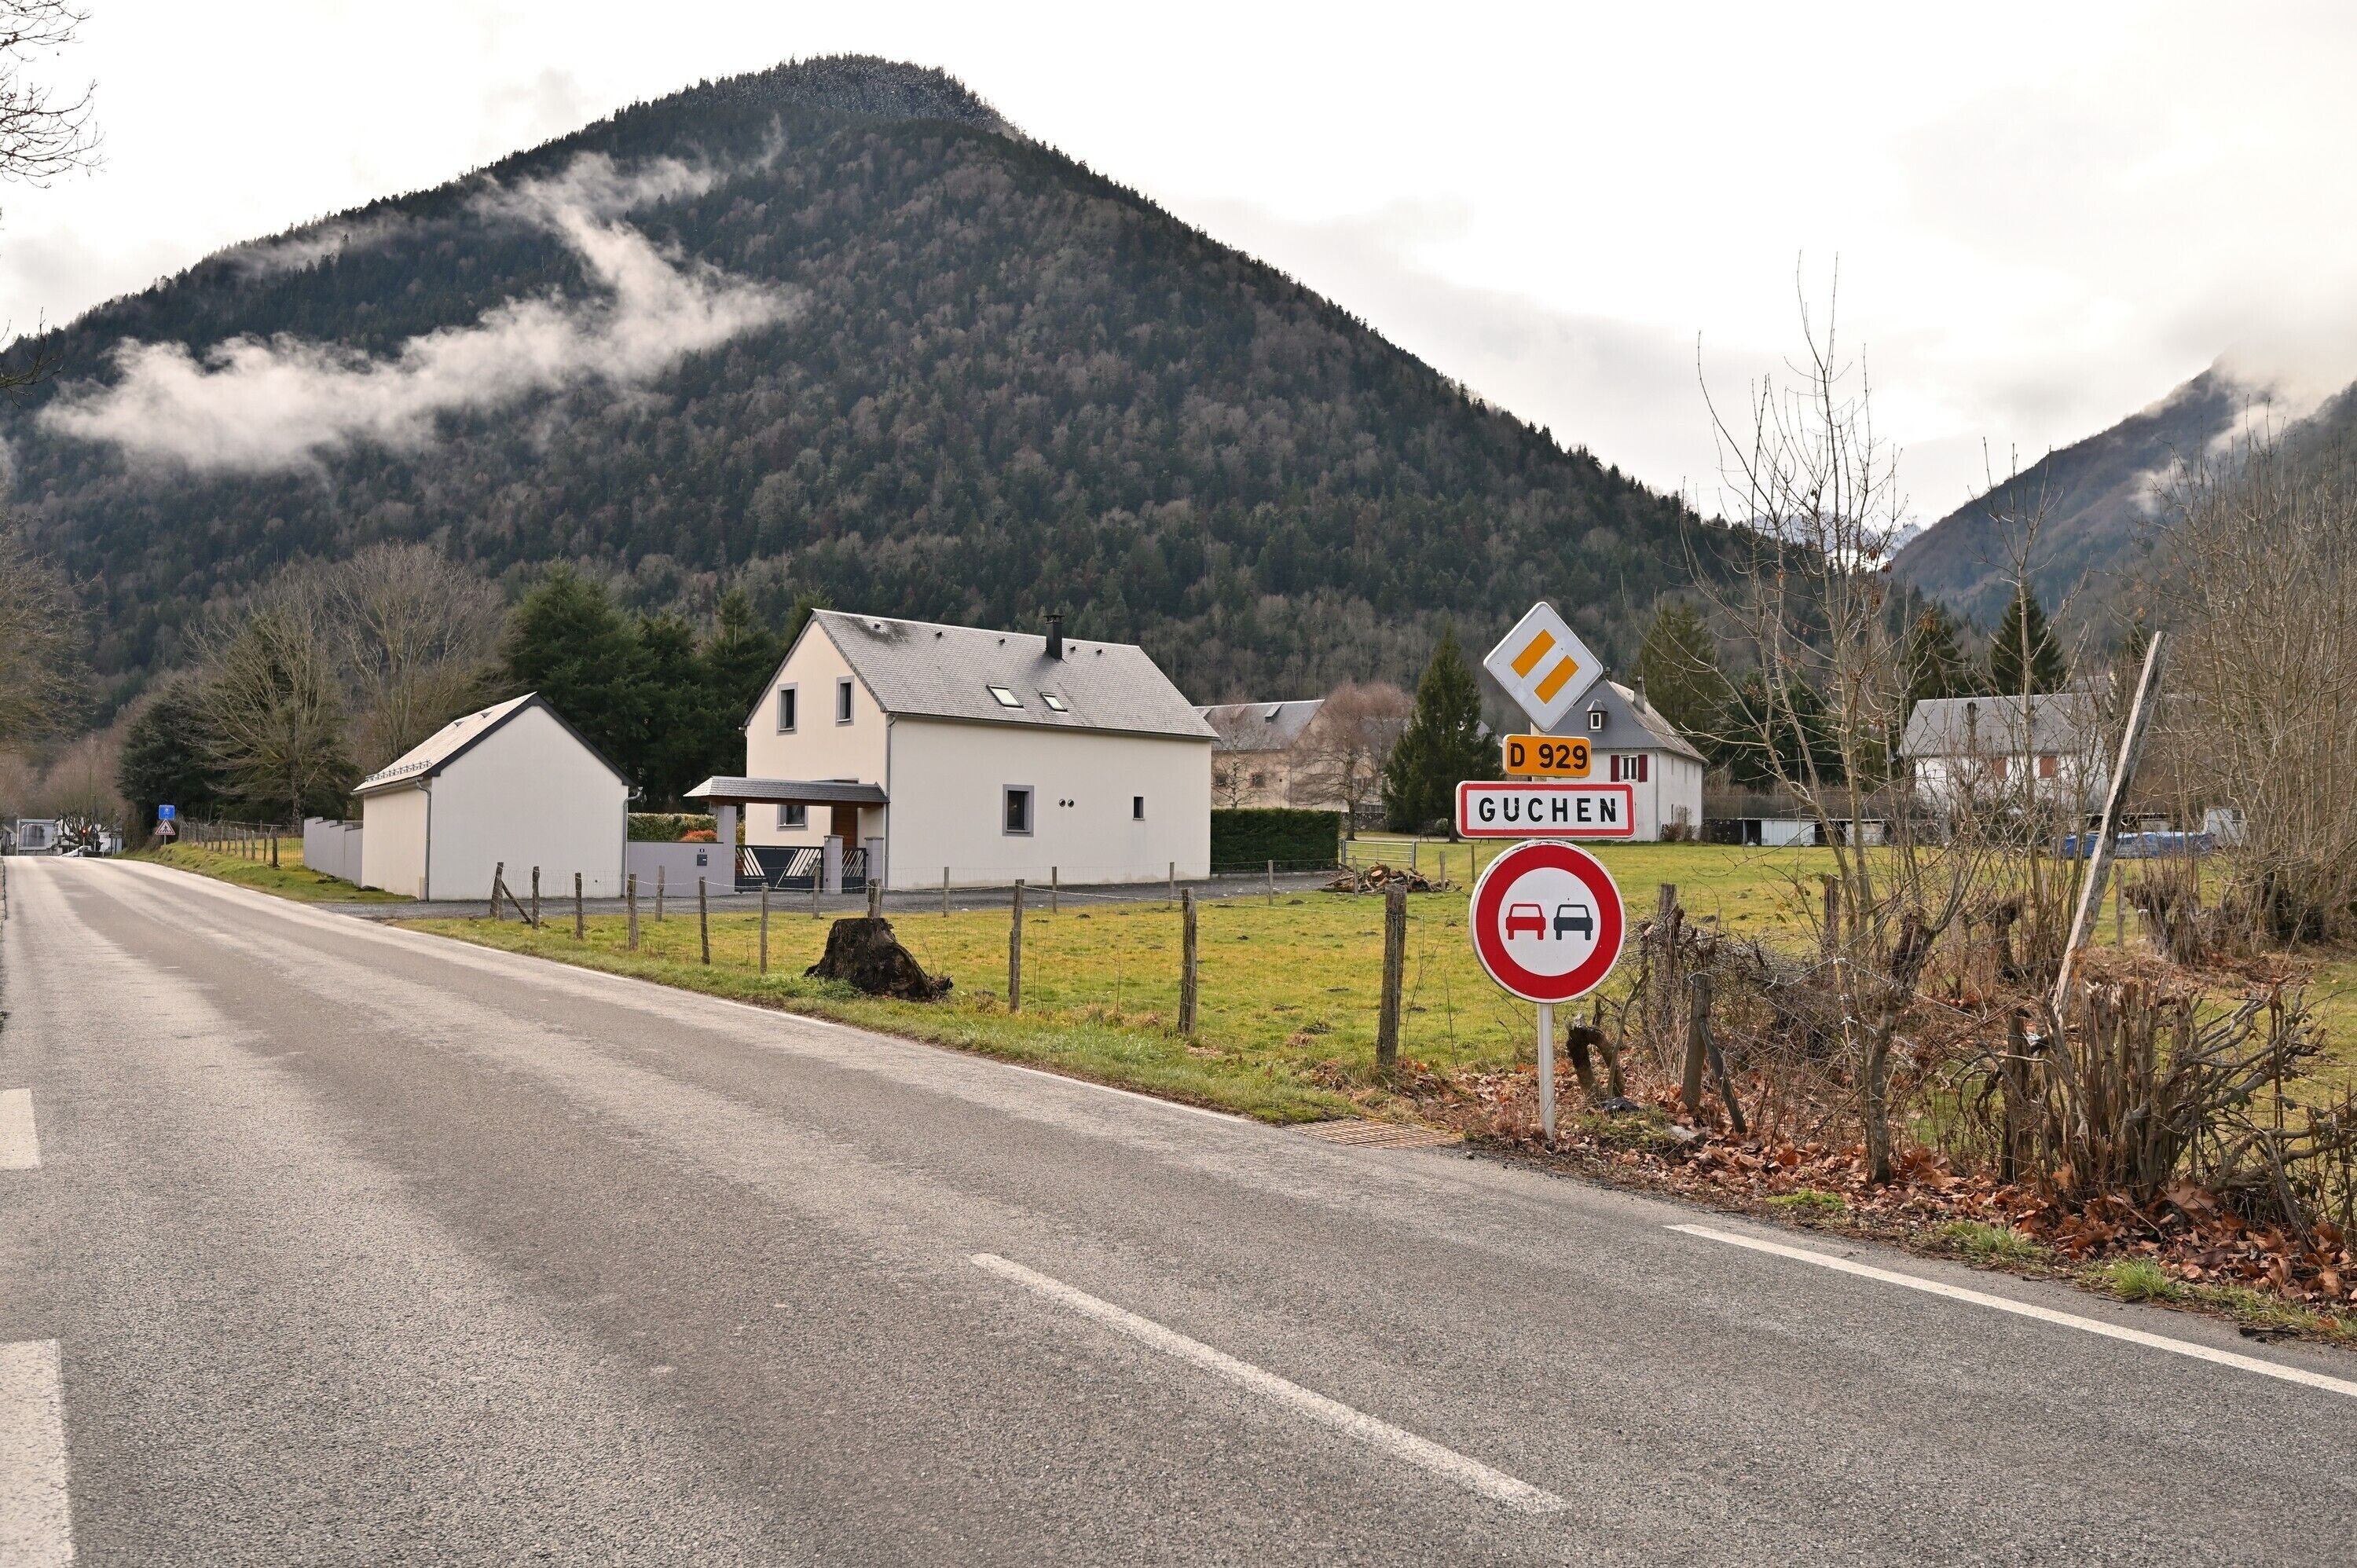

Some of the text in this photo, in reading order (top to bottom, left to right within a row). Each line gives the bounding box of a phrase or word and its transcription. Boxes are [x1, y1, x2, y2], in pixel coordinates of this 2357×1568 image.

[1510, 742, 1588, 770] D 929
[1479, 797, 1617, 822] GUCHEN
